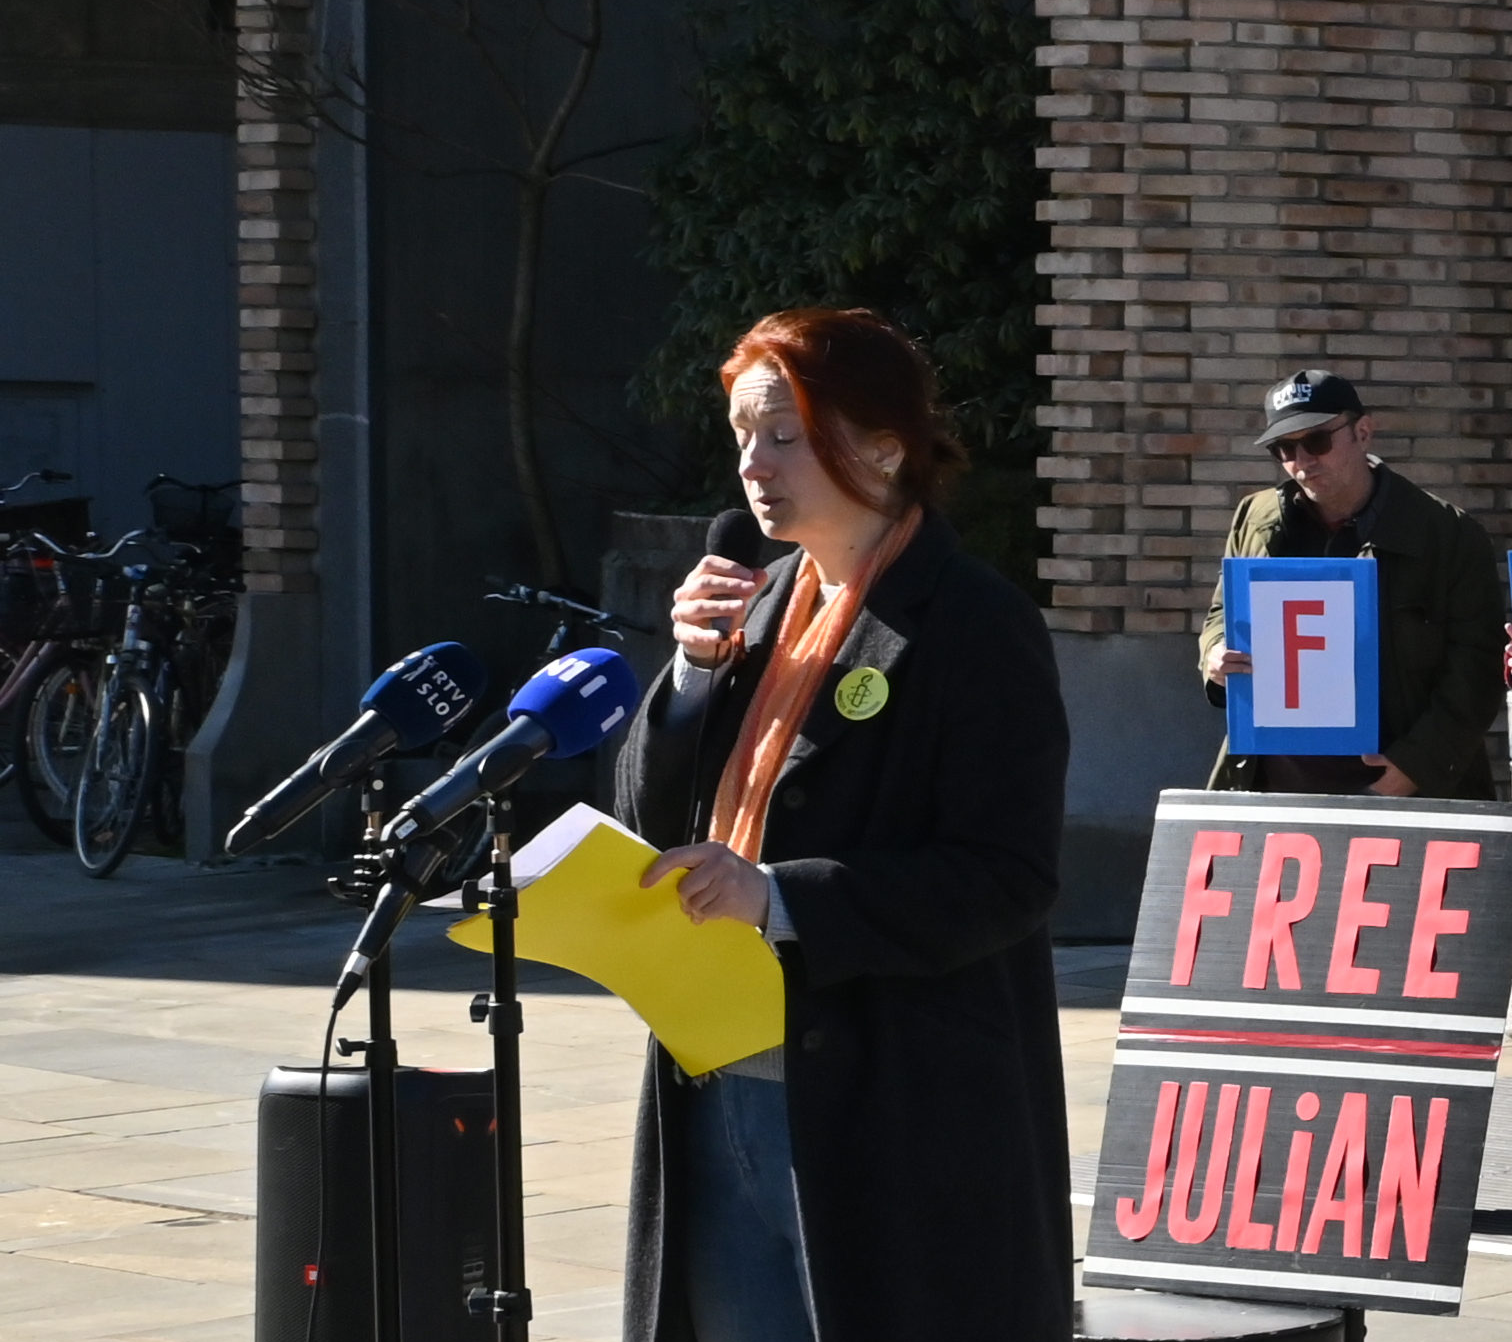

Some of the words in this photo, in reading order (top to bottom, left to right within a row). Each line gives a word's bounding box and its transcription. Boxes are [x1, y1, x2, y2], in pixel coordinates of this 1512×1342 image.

[431, 670, 466, 702] RTV
[1285, 599, 1325, 709] F
[416, 682, 451, 716] SLO
[1169, 829, 1482, 1000] FREE
